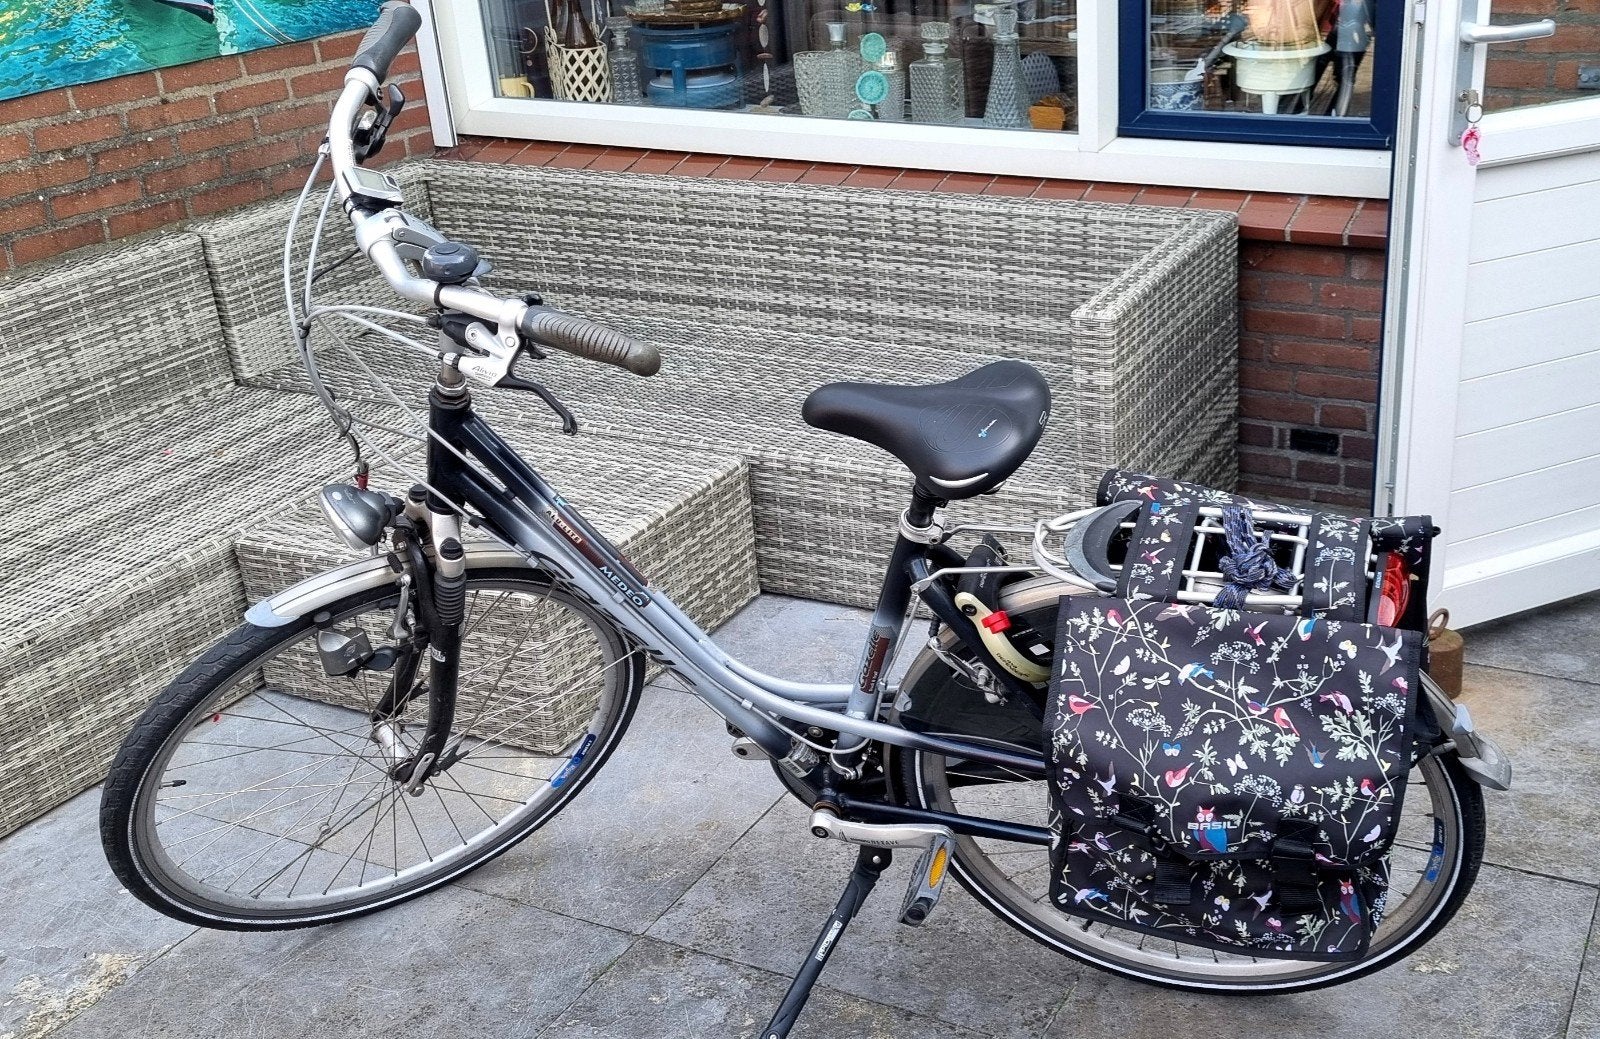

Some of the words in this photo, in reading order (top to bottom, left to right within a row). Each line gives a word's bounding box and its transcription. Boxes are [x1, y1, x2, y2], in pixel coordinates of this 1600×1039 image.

[599, 565, 644, 607] MEDEO
[858, 630, 880, 688] Gazelle
[1187, 821, 1238, 831] BASIL
